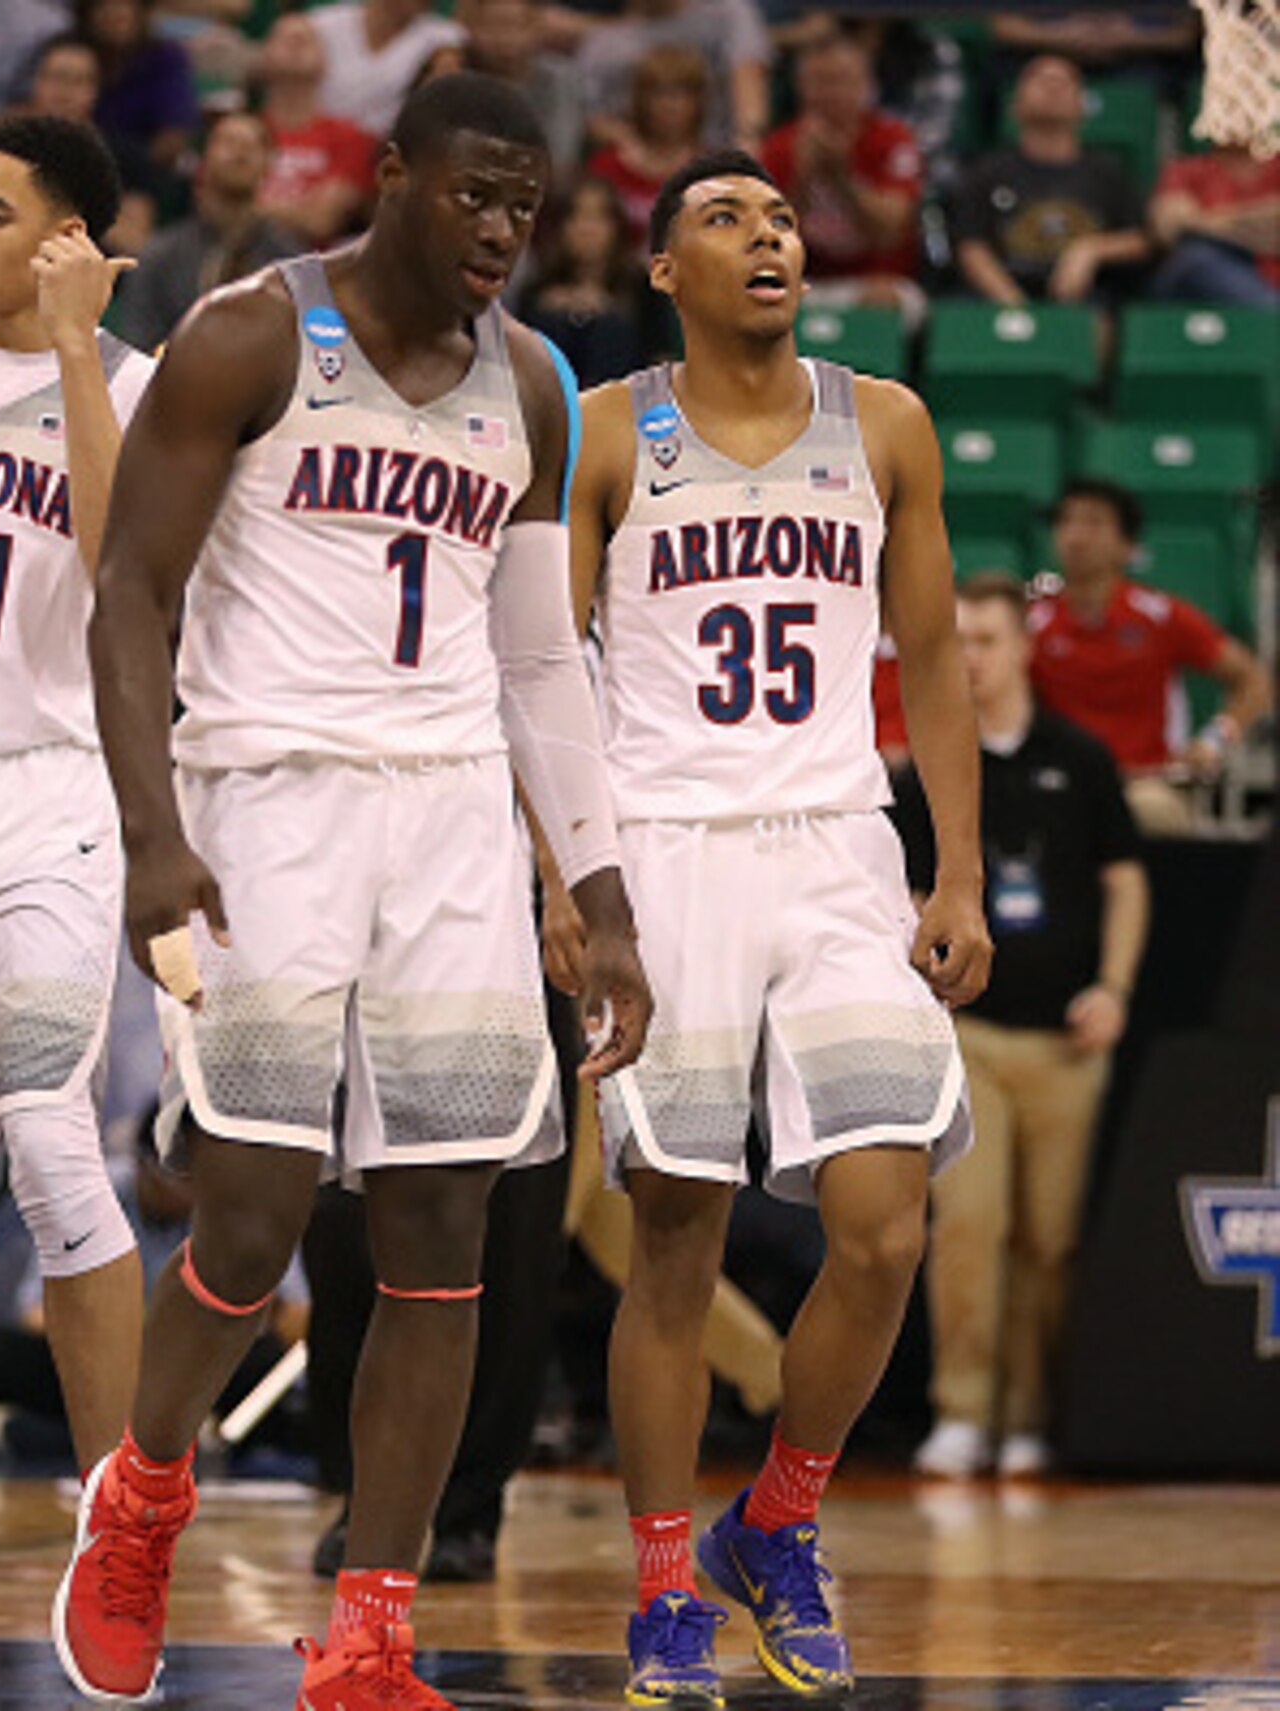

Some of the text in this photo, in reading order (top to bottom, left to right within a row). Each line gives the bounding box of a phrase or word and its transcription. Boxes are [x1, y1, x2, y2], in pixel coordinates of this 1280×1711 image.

[283, 444, 509, 548] ARIZONA
[387, 529, 428, 668] 1
[648, 514, 863, 594] ARIZONA
[697, 603, 816, 724] 35
